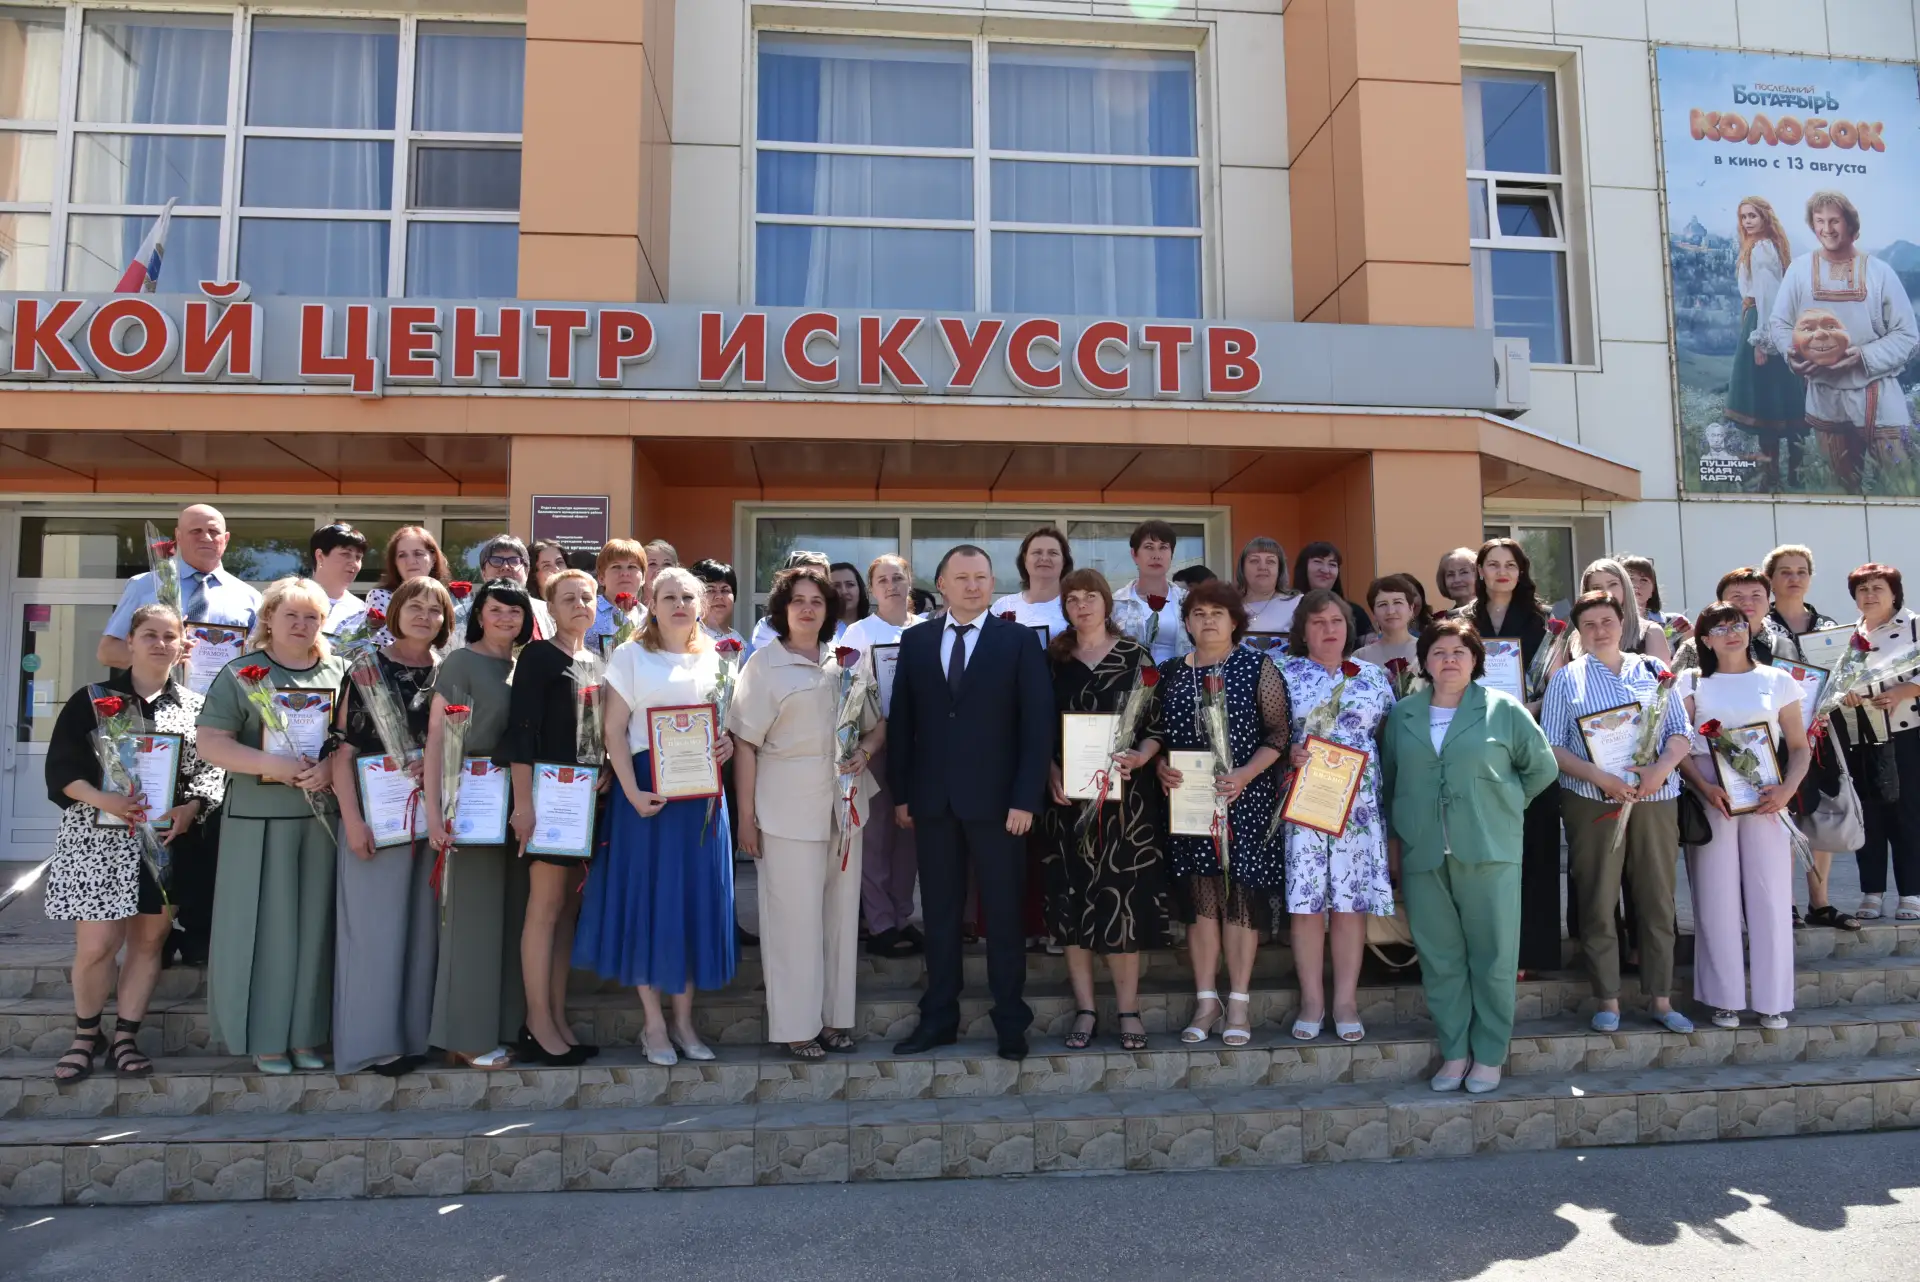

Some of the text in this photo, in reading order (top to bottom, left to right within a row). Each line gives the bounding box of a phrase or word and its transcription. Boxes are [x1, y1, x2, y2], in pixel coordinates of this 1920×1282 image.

[1754, 82, 1815, 94] ПОСЛЕДНИЙ
[1689, 108, 1886, 153] КОЛОБОК
[1728, 156, 1768, 168] кино
[1787, 157, 1804, 170] 13
[1809, 161, 1867, 176] августа
[0, 280, 1264, 396] КОЙ ЦЕНТР ИСКУССТВ
[1700, 460, 1757, 468] ПУШКИН
